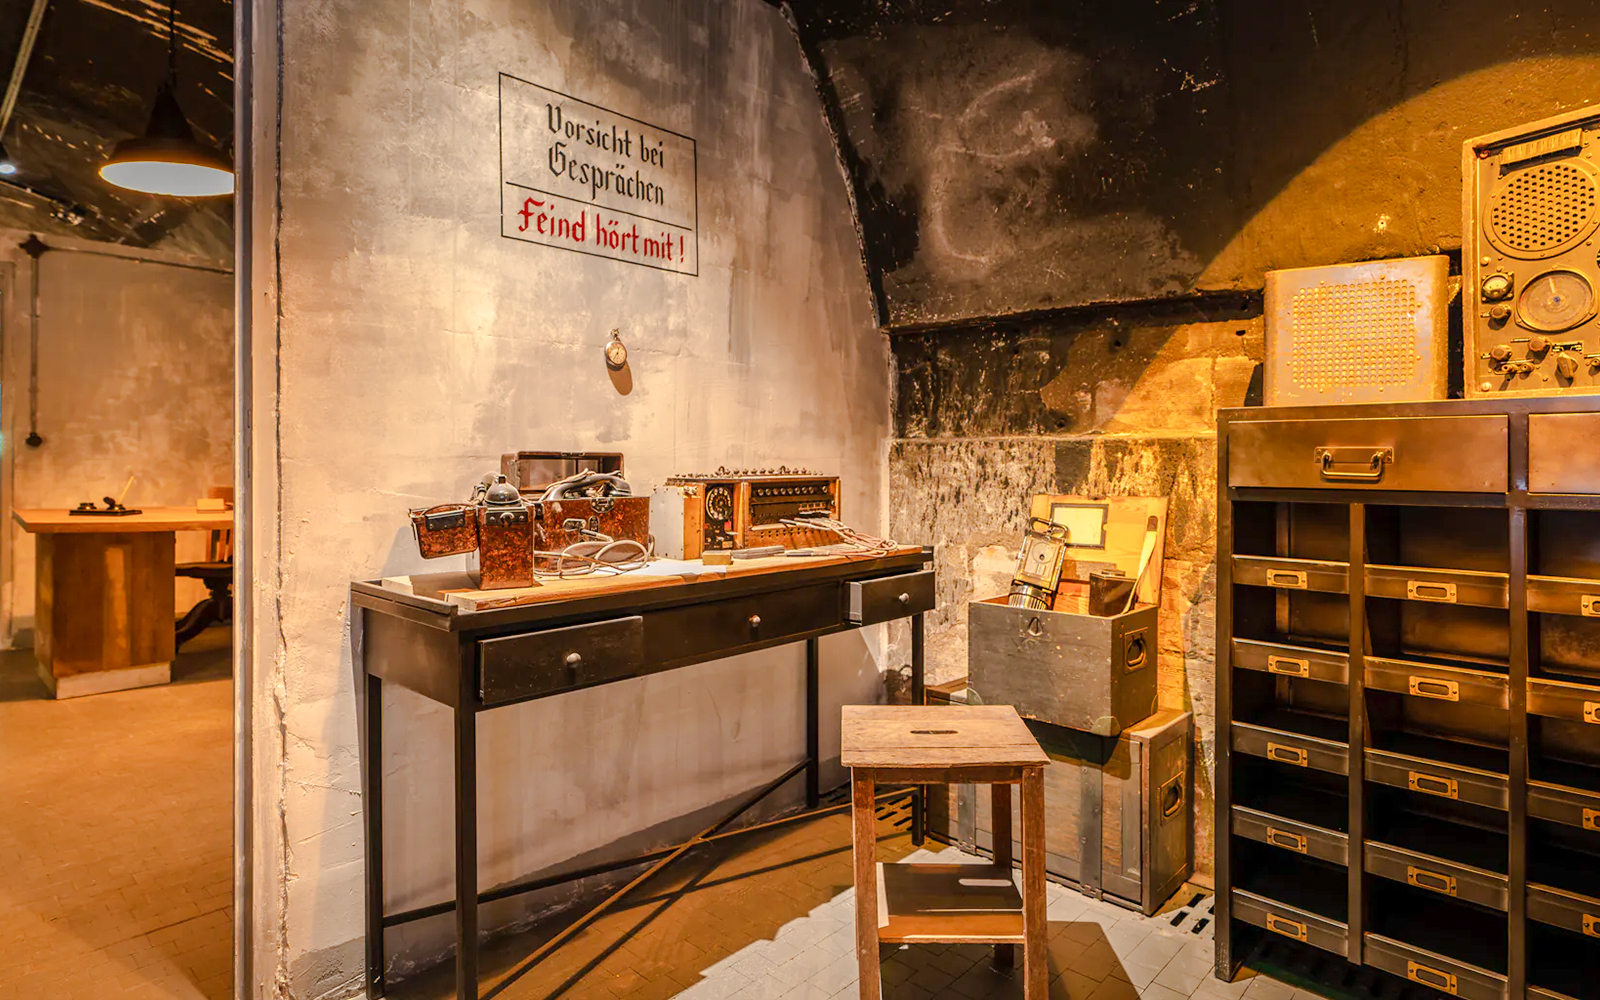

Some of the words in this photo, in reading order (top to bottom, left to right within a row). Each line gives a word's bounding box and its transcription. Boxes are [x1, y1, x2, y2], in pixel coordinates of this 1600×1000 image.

[546, 102, 632, 157] Vorsicht
[640, 135, 664, 168] bei
[549, 141, 664, 206] Gesprächen
[517, 197, 585, 242] Feind
[596, 213, 639, 254] hört
